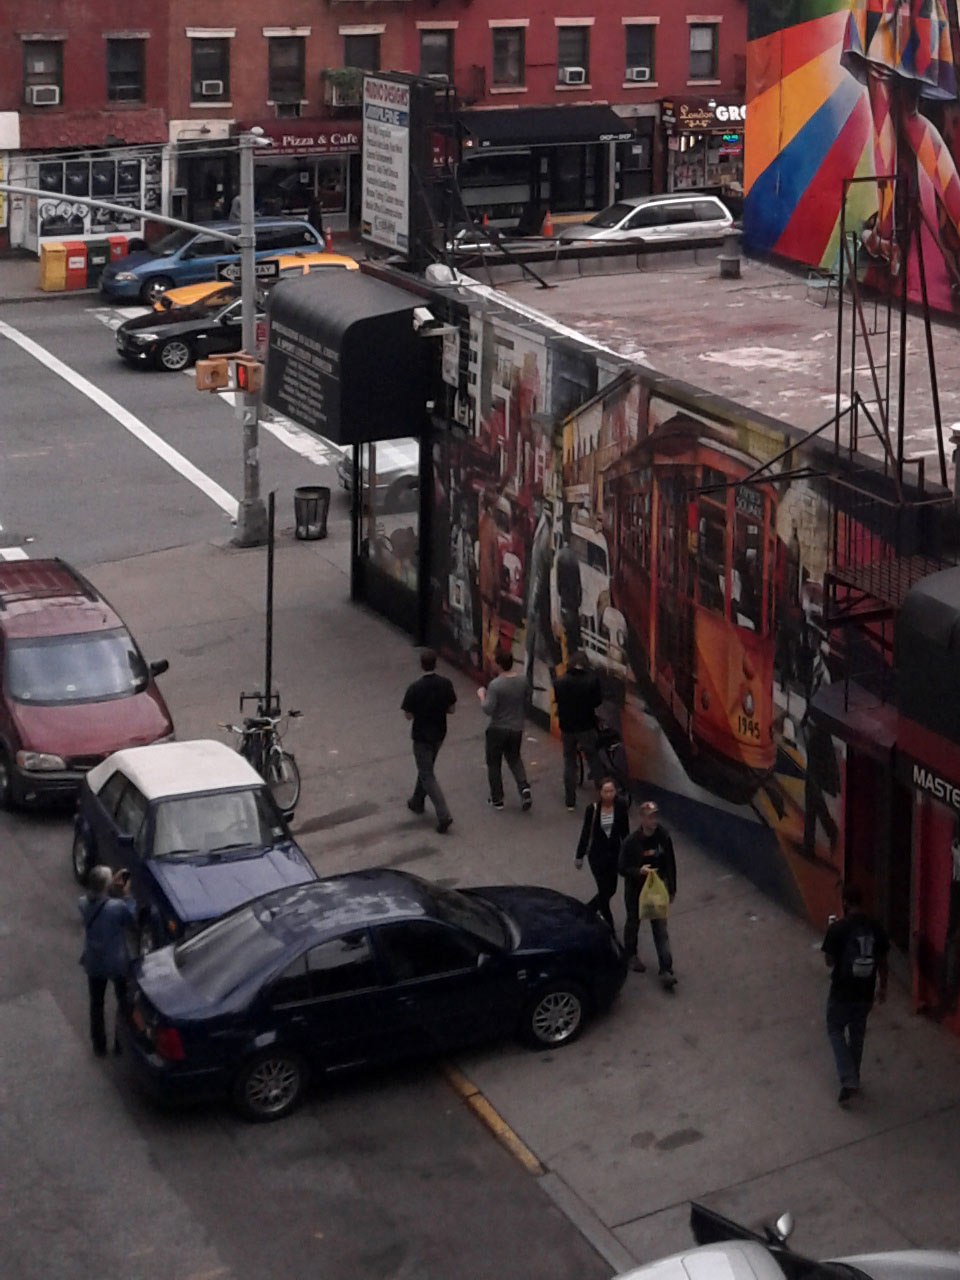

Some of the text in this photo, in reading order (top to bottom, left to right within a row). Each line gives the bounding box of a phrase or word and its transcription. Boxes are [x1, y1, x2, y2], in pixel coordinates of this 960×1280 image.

[282, 135, 314, 147] Pizza
[317, 133, 327, 145] &
[330, 132, 359, 145] Cafe
[738, 715, 760, 739] 1945
